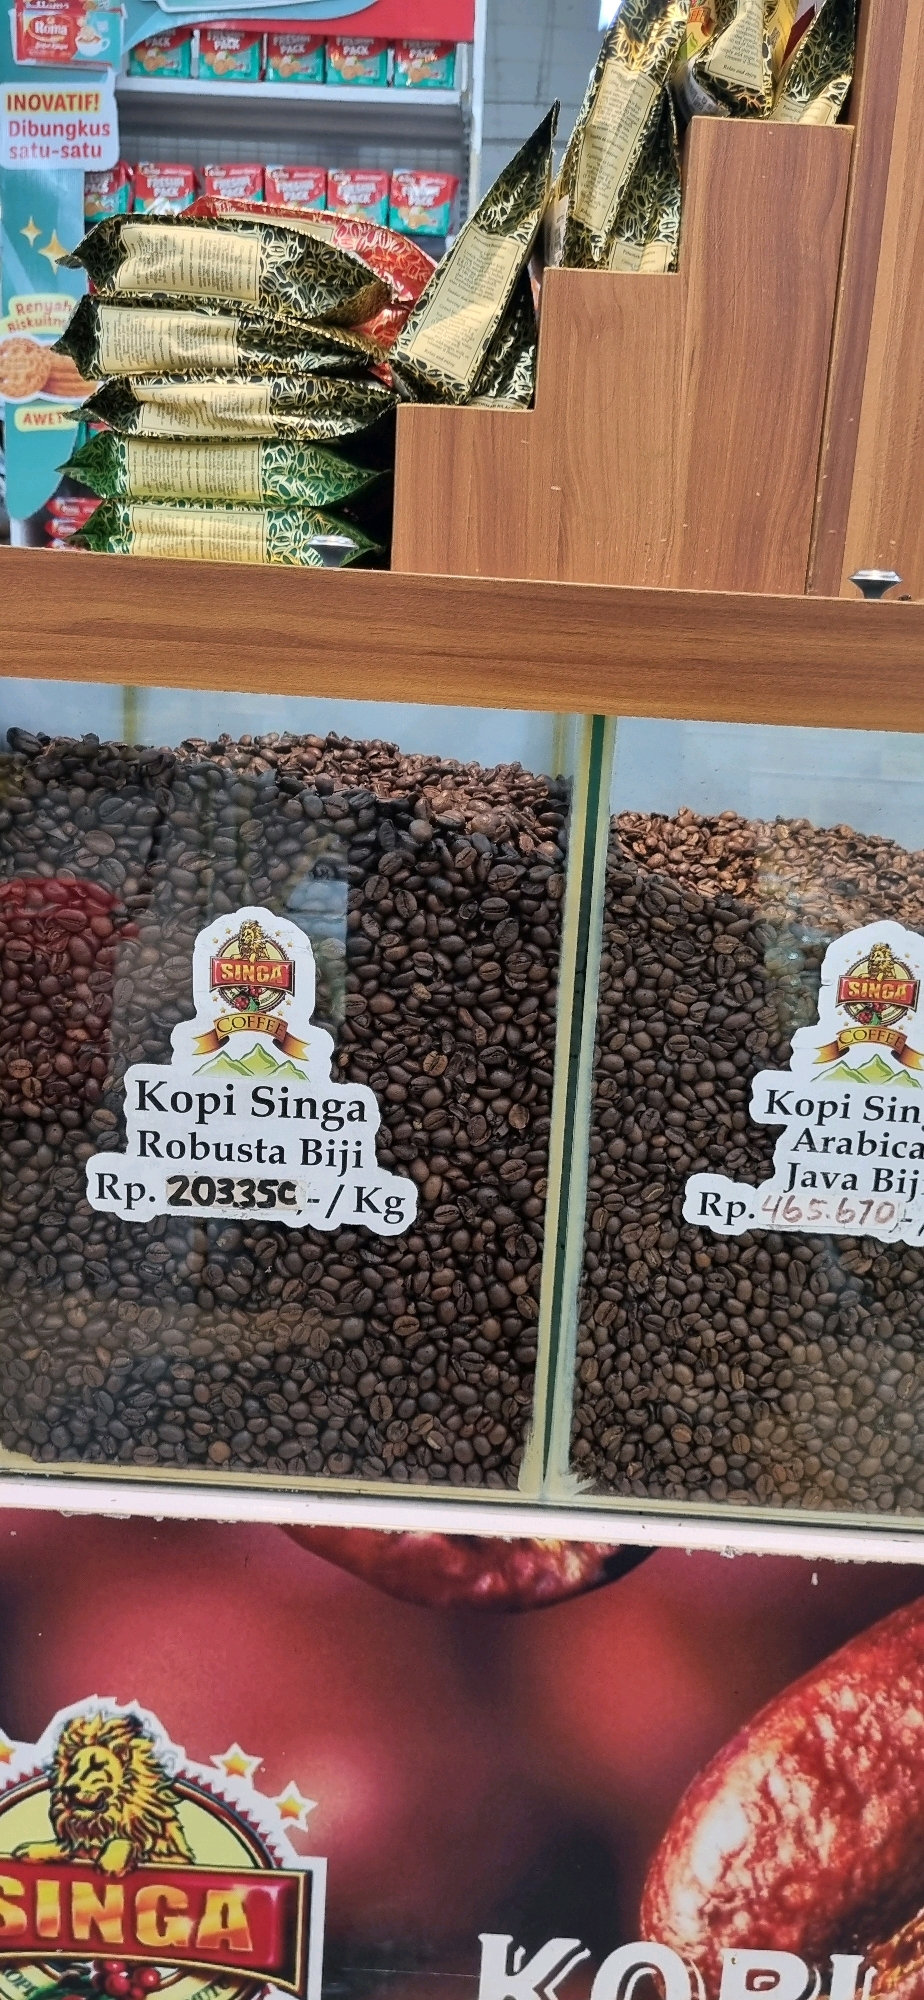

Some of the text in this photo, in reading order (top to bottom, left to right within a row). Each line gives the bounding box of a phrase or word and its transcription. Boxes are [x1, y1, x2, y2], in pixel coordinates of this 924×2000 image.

[35, 20, 68, 35] Roma
[214, 38, 240, 50] PACK
[280, 44, 305, 54] PACK
[343, 46, 369, 56] PACK
[7, 92, 99, 112] INOVATIF!
[8, 119, 111, 142] Dibungkus
[9, 143, 102, 159] satu-satu
[15, 300, 72, 316] Renyah
[220, 962, 283, 985] SINGA
[848, 981, 907, 1001] SINGA
[216, 1016, 287, 1036] COFFEE
[838, 1029, 905, 1047] COFFEE
[134, 1080, 367, 1132] Kopi Singa
[764, 1089, 924, 1133] Kopi Sin
[137, 1130, 364, 1178] Robusta Biji
[790, 1128, 924, 1160] Arabica
[784, 1162, 859, 1194] Java
[94, 1172, 156, 1211] Rp.
[696, 1191, 755, 1227] Rp.
[0, 1875, 253, 1952] SINGA
